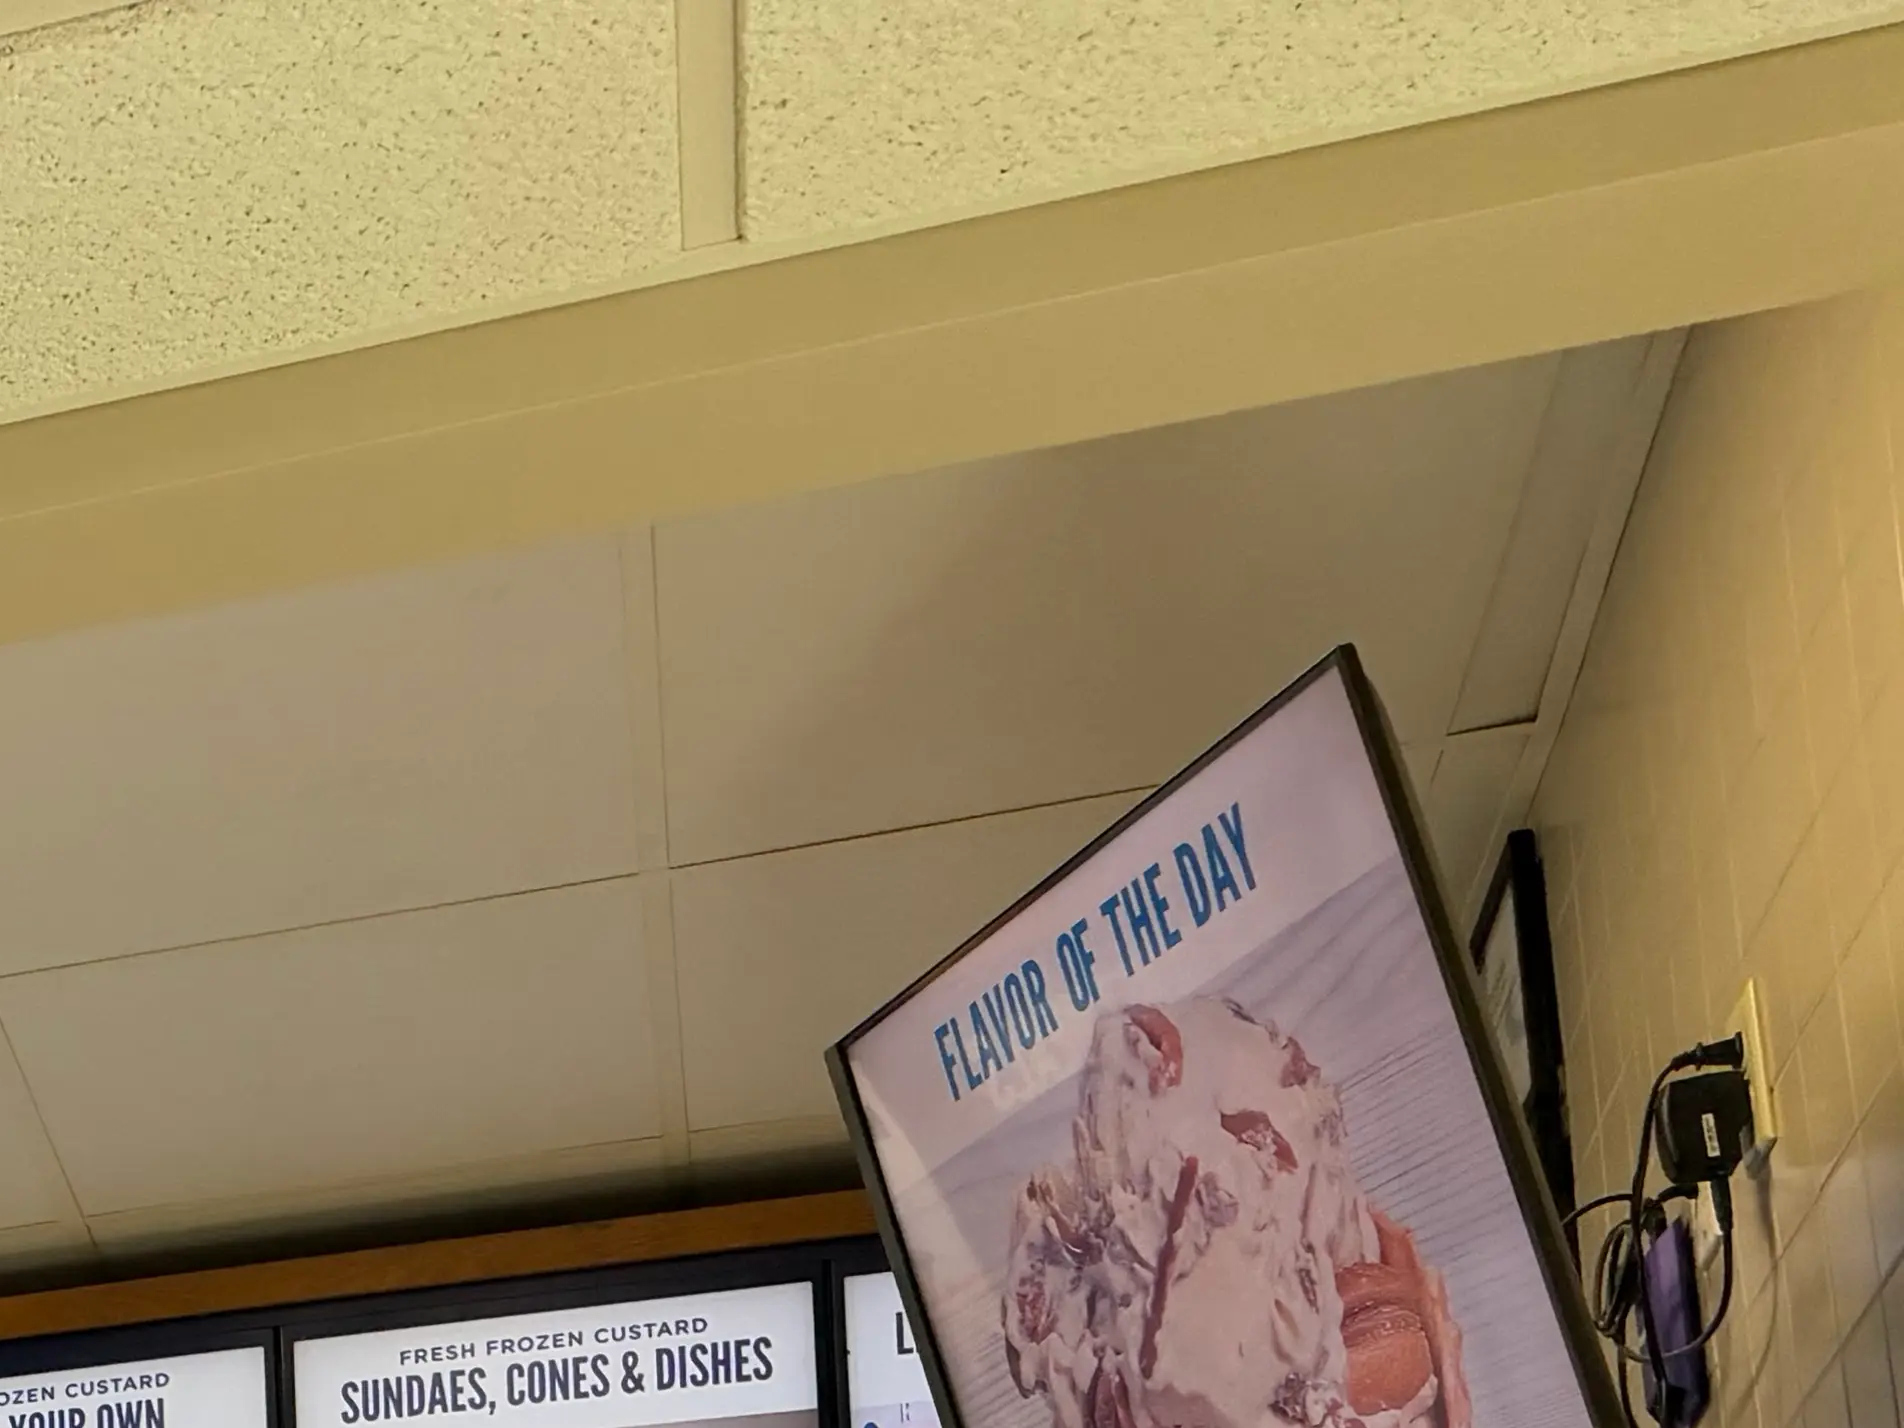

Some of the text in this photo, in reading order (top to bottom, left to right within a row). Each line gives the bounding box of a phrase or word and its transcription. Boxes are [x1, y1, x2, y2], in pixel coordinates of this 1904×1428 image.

[927, 802, 1256, 1101] FLAVOR OF THE DAY
[400, 1318, 707, 1365] FRESH FROZEN CUSTARD
[65, 1373, 169, 1398] CUSTARD
[341, 1337, 772, 1424] SUNDAES, CONES & DISHES
